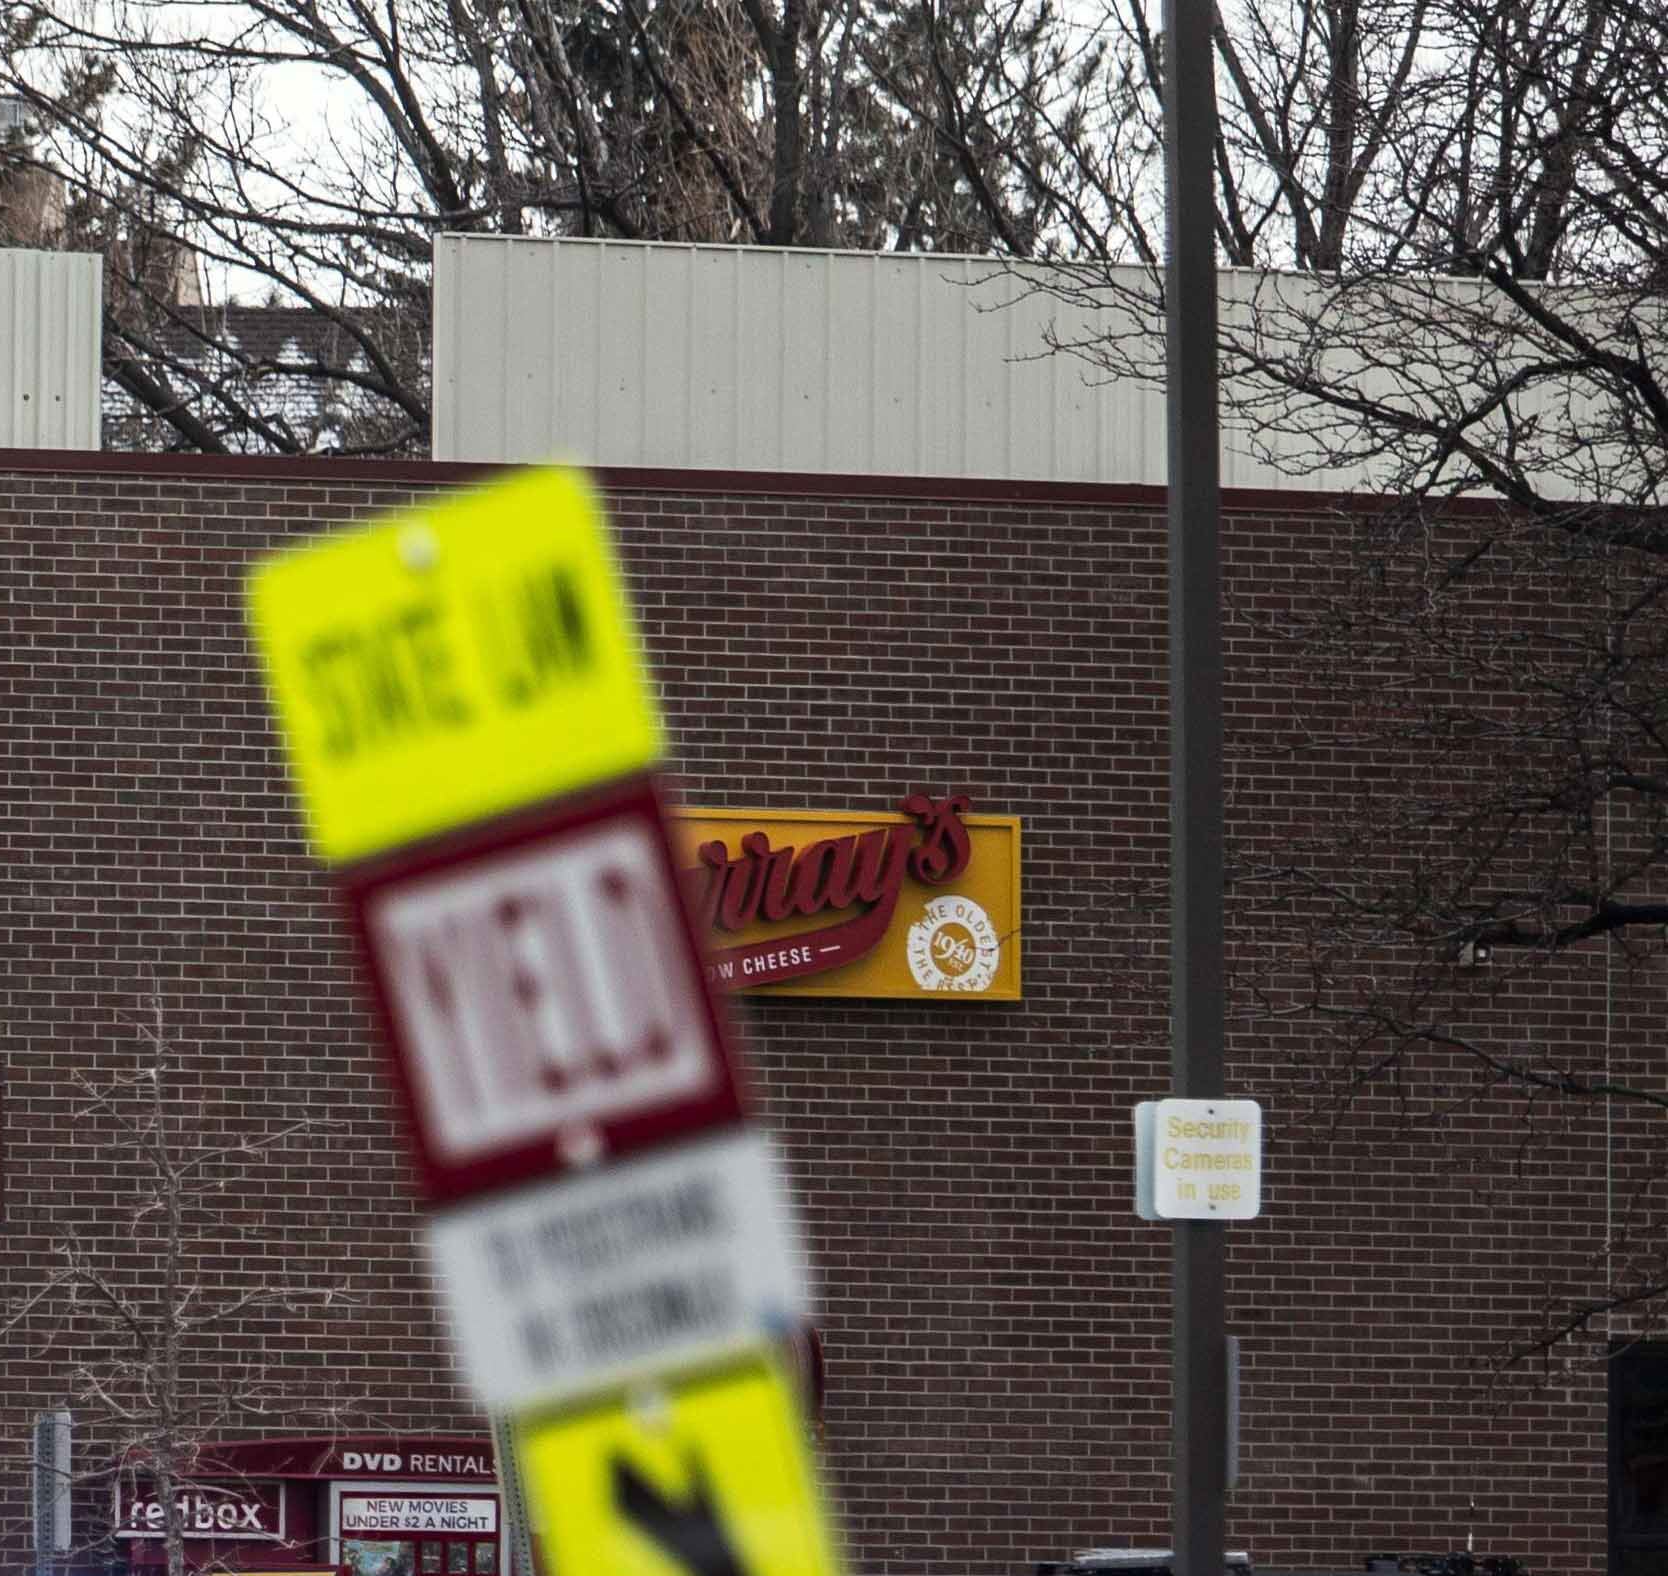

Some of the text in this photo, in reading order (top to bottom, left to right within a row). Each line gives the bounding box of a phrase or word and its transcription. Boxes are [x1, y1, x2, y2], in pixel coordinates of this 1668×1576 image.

[744, 946, 812, 975] CHEESE
[1168, 1115, 1250, 1143] Security
[1163, 1147, 1253, 1169] Cameras
[1177, 1178, 1242, 1200] in use
[343, 1452, 402, 1471] DVD
[366, 1501, 468, 1513] NEW MOVIES
[346, 1516, 489, 1529] UNDER $2 A NIGHT
